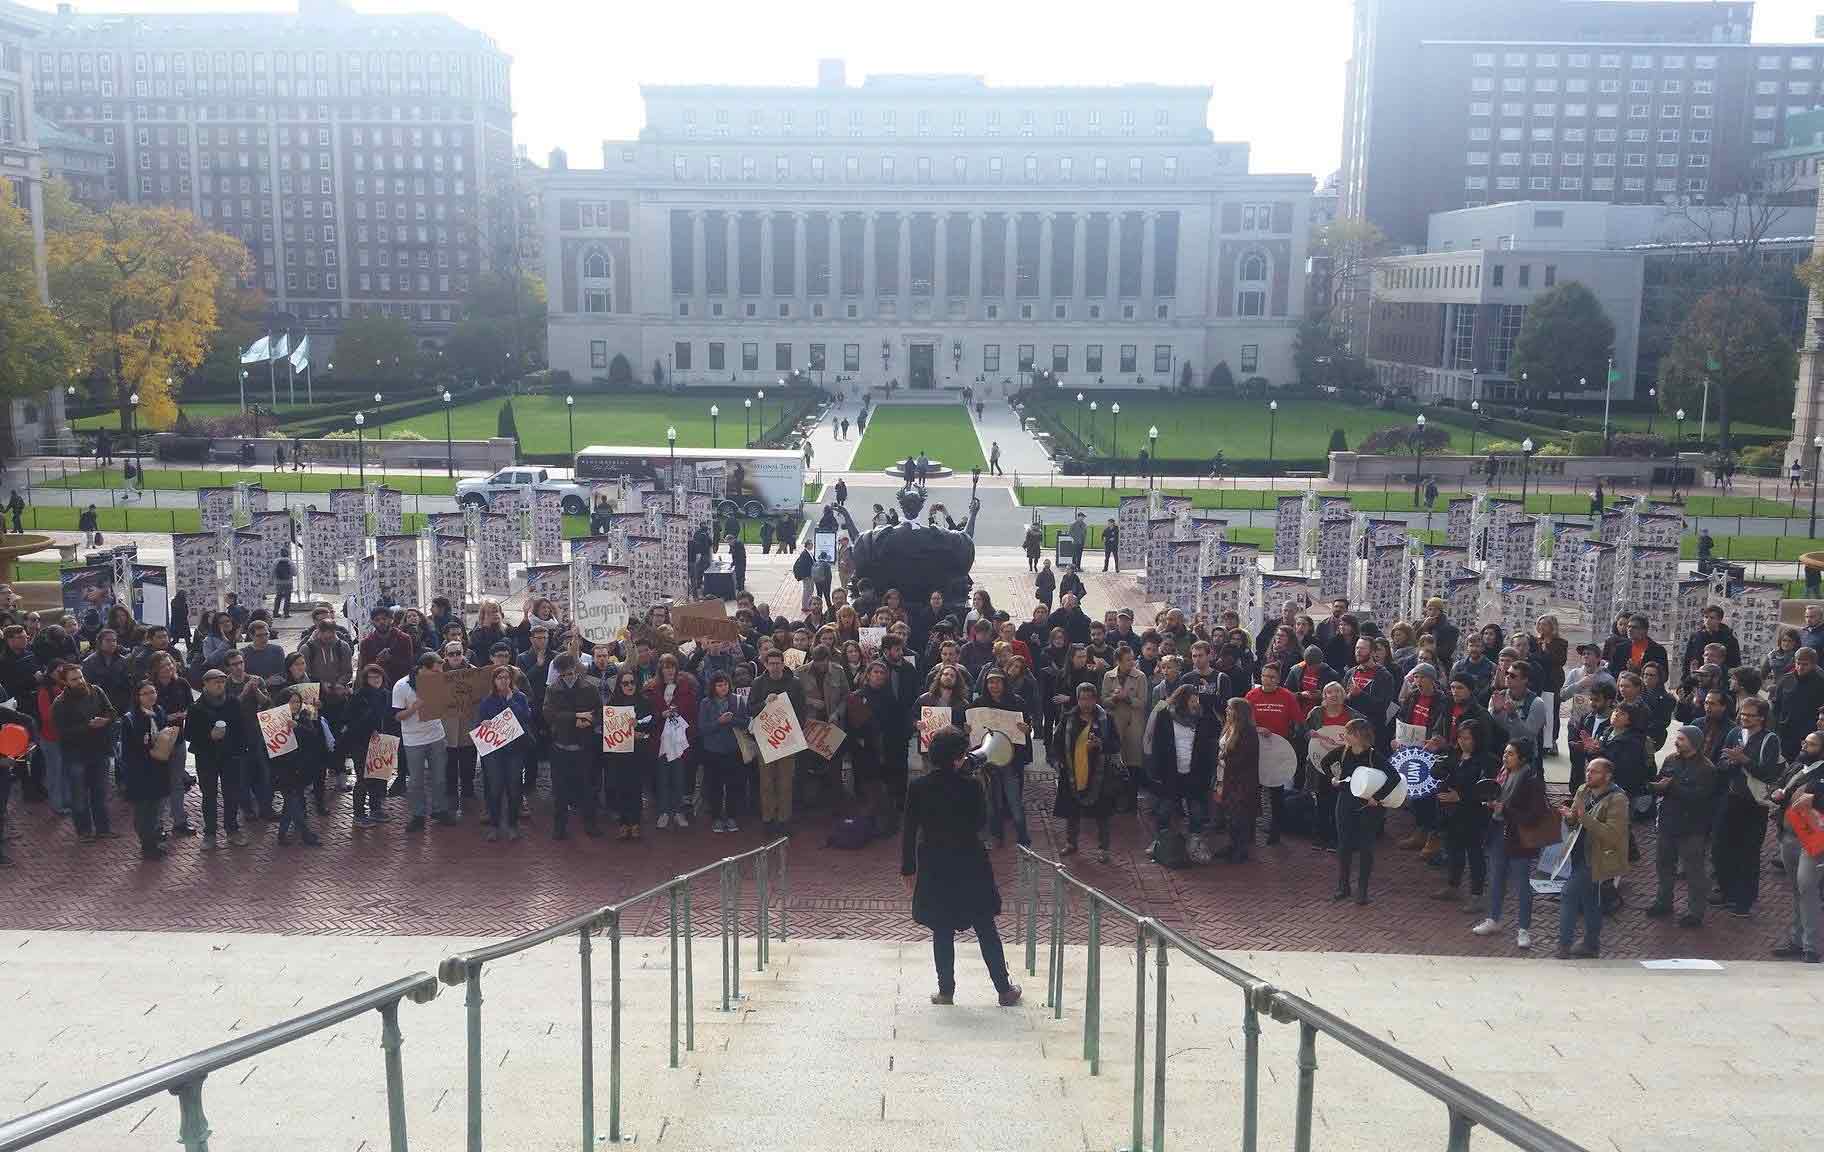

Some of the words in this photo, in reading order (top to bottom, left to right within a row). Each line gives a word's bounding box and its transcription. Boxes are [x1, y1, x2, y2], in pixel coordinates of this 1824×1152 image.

[475, 725, 507, 748] NOW
[604, 722, 633, 748] NOW
[768, 718, 792, 749] NOW
[366, 753, 394, 774] NOW
[1407, 761, 1421, 783] UAW
